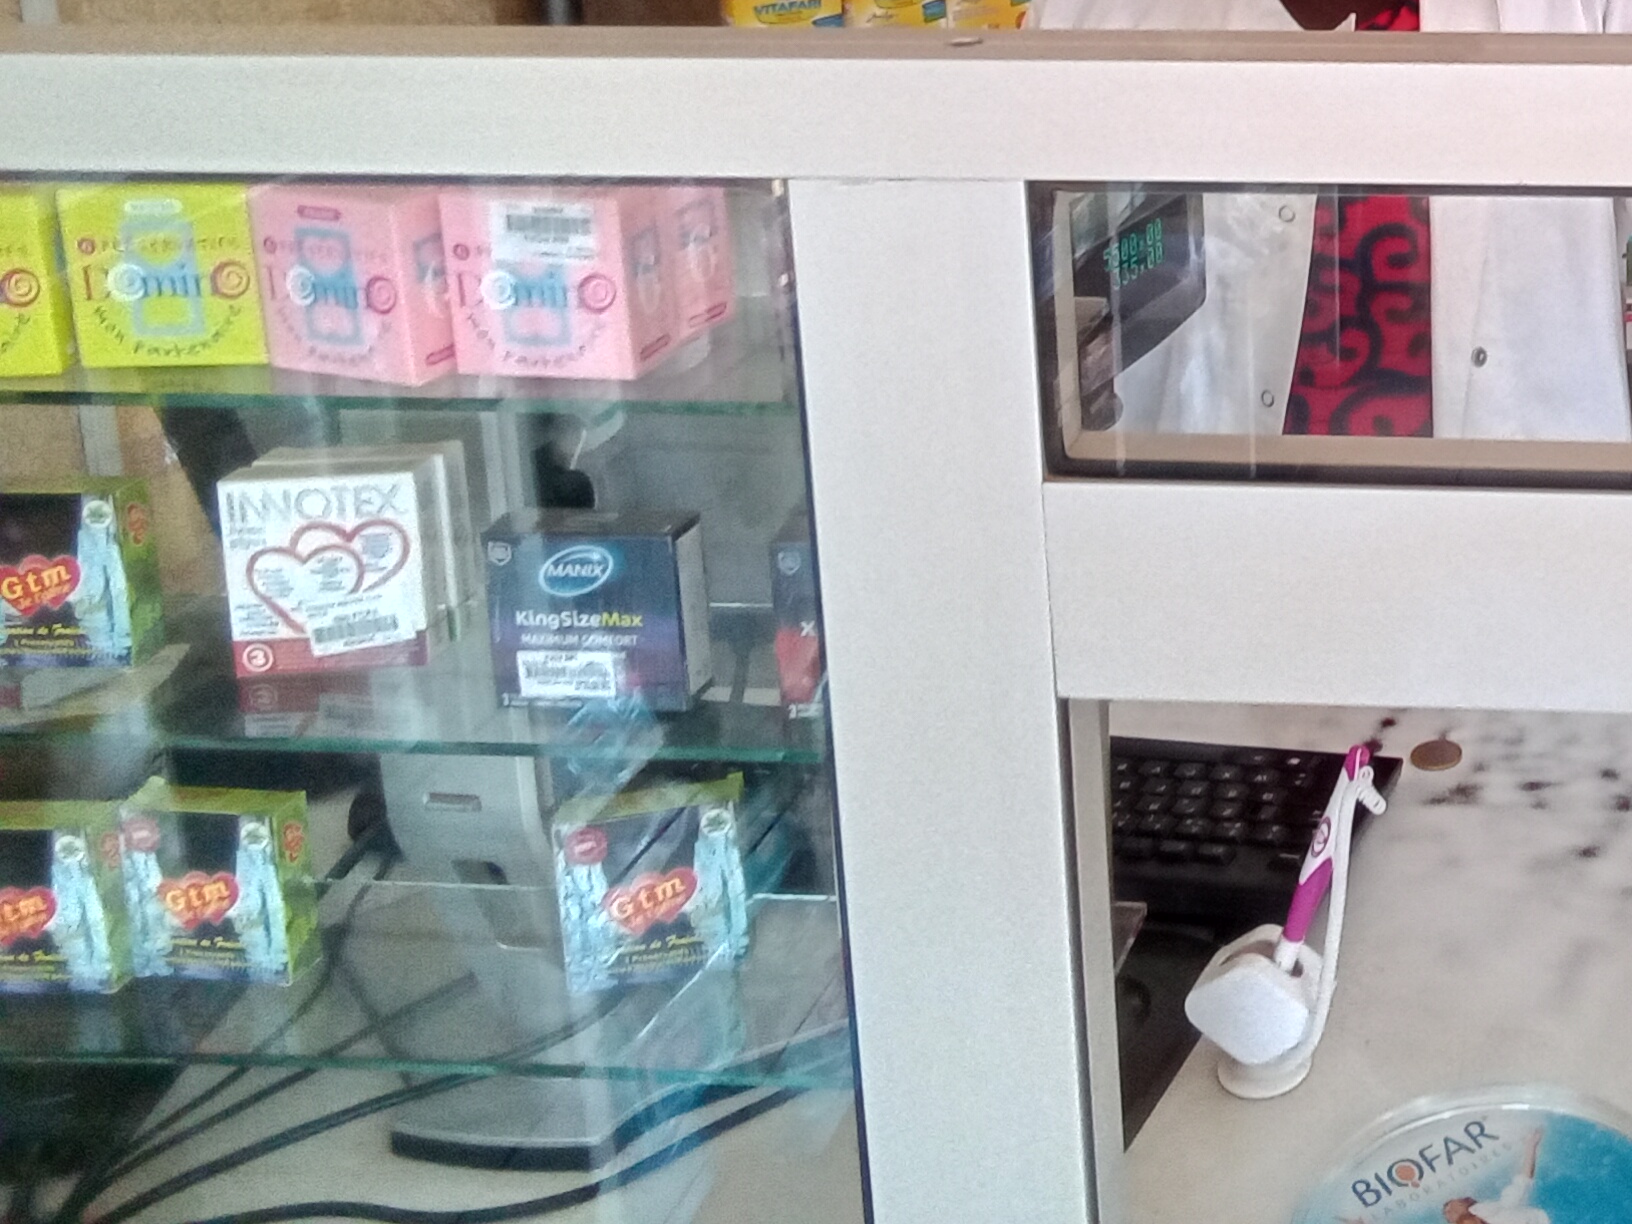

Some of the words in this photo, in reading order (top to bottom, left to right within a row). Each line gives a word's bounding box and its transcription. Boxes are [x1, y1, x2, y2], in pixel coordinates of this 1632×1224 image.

[226, 483, 409, 524] INNOTEX
[547, 563, 606, 577] MANIX
[515, 609, 644, 630] KingSizeMax
[165, 880, 231, 912] Gtm
[1351, 1120, 1500, 1208] BIOFAR
